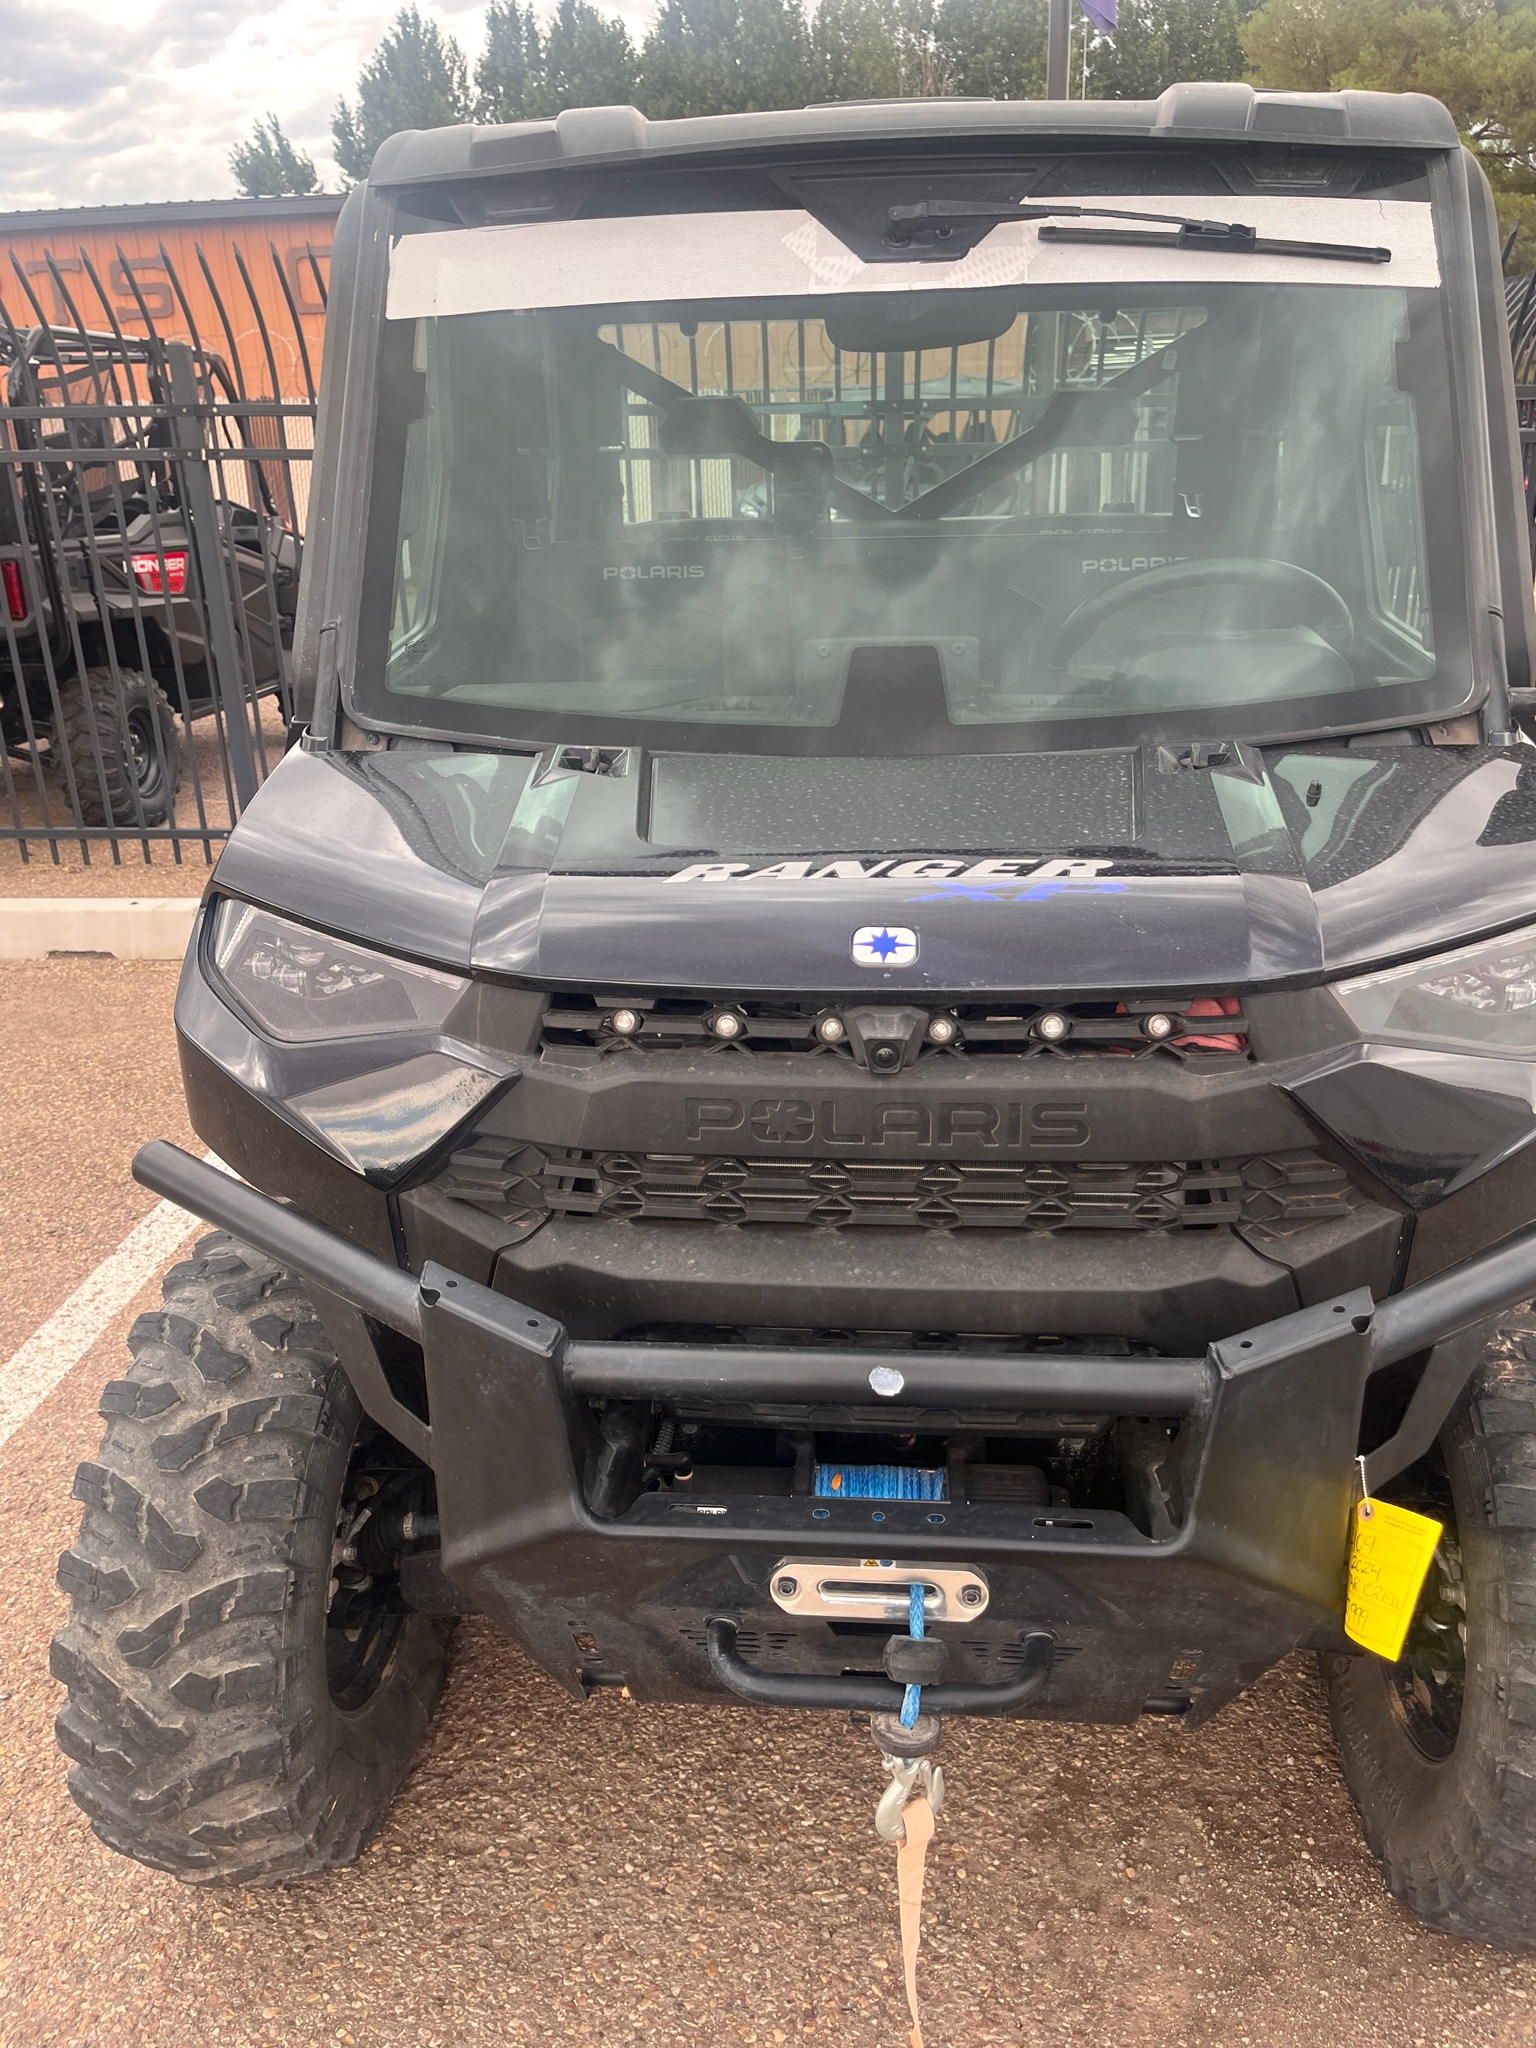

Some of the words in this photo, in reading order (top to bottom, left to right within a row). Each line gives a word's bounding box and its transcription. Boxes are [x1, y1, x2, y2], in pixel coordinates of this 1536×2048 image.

[602, 565, 705, 581] POLARIS
[1082, 556, 1189, 574] POLAR
[661, 858, 1115, 884] RANGER
[903, 881, 1131, 902] XP
[685, 1096, 1092, 1148] POLARIS
